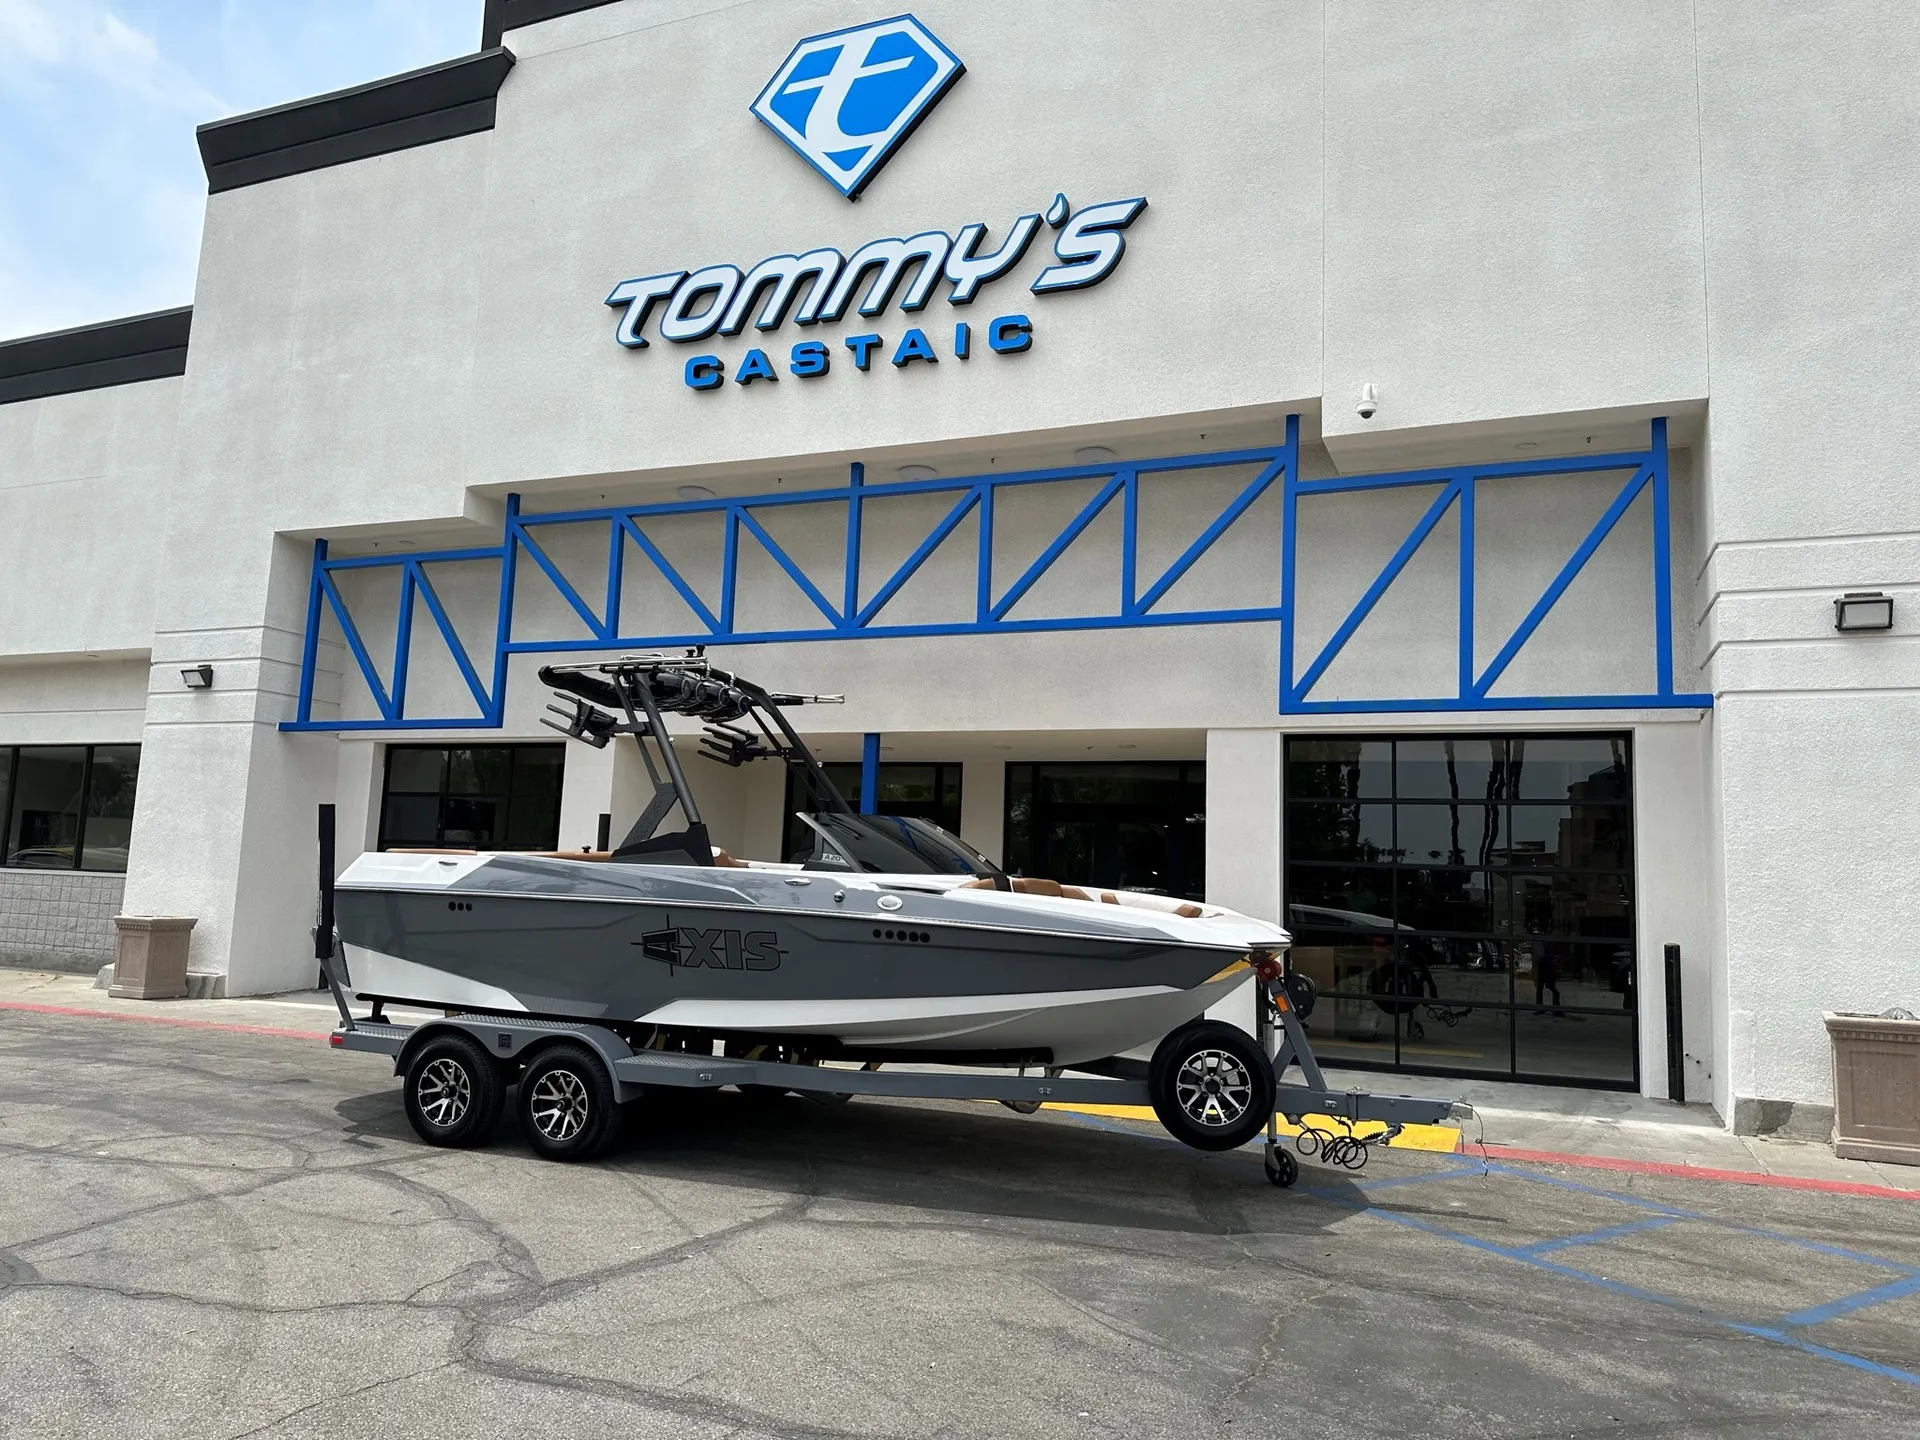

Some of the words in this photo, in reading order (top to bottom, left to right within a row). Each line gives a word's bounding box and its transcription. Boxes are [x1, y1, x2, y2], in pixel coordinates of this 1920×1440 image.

[605, 193, 1147, 347] TOMMY'S
[684, 314, 1032, 389] CASTAIC
[641, 927, 781, 972] AXIS
